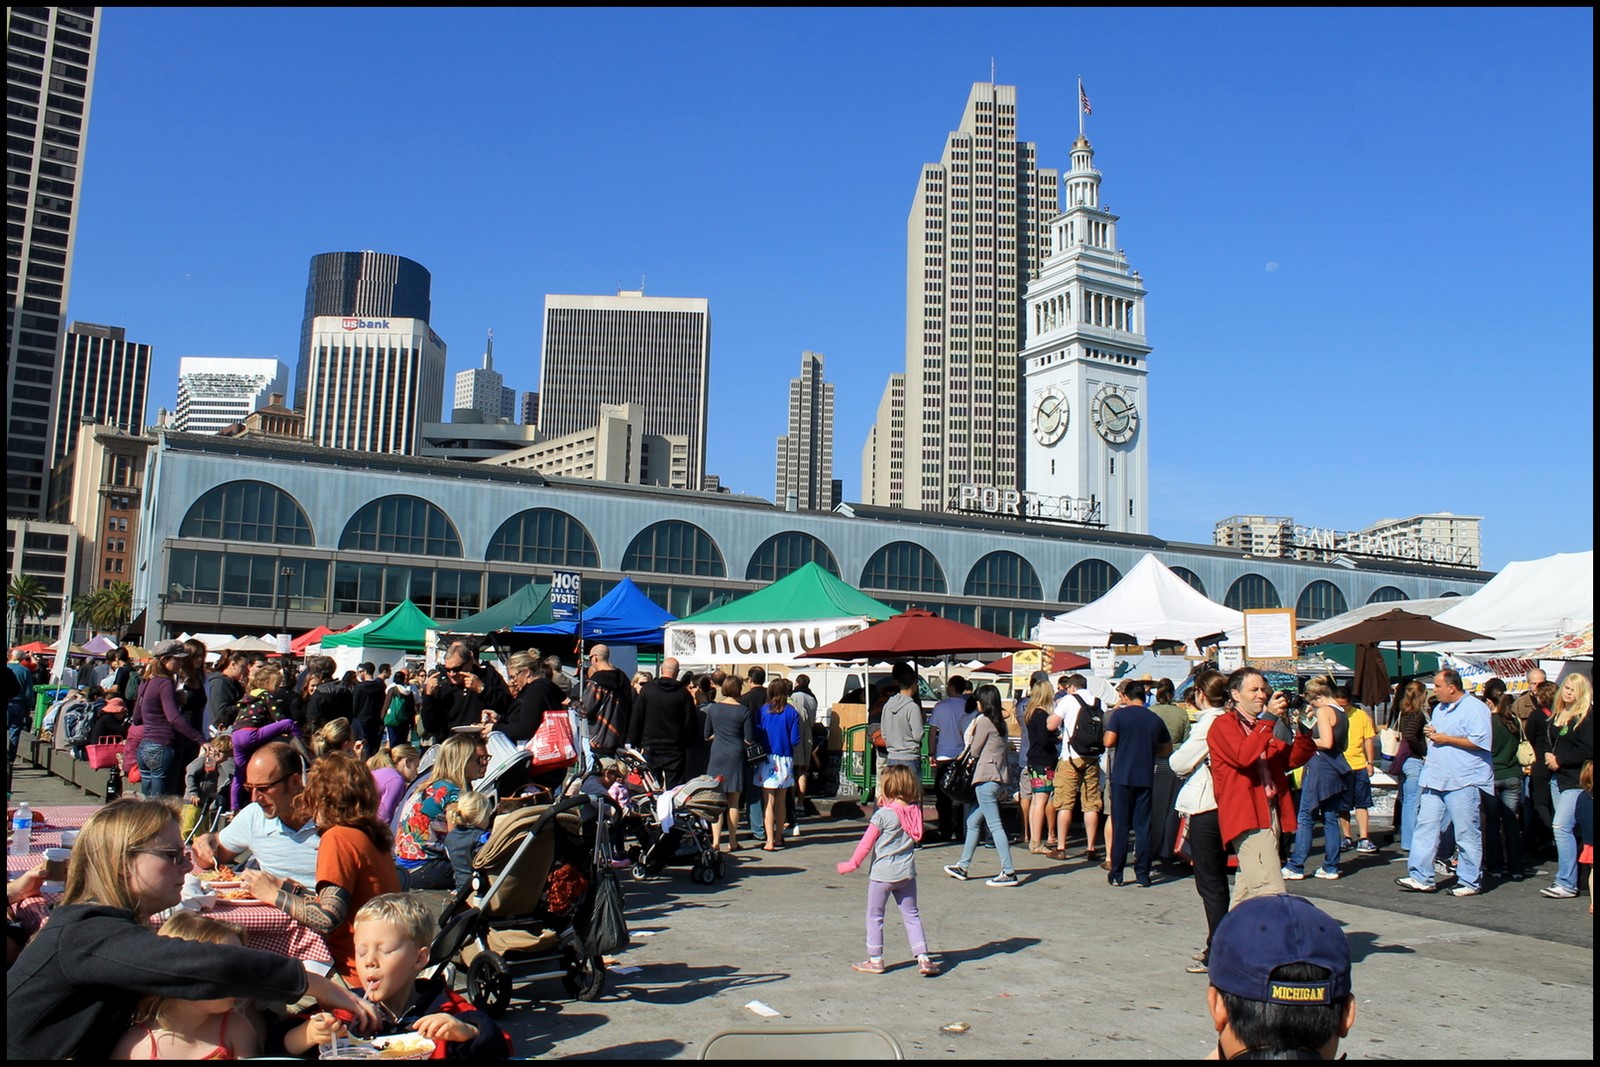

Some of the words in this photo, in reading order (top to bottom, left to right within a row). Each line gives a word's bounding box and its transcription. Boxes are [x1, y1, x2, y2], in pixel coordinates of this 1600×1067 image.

[959, 483, 1039, 517] PORT
[1059, 495, 1092, 522] OF
[1293, 525, 1336, 551] SAN
[1346, 532, 1457, 563] FRANCISCO
[552, 573, 580, 590] HOG
[709, 627, 821, 655] namu
[1272, 985, 1325, 1001] MICHIGAN
